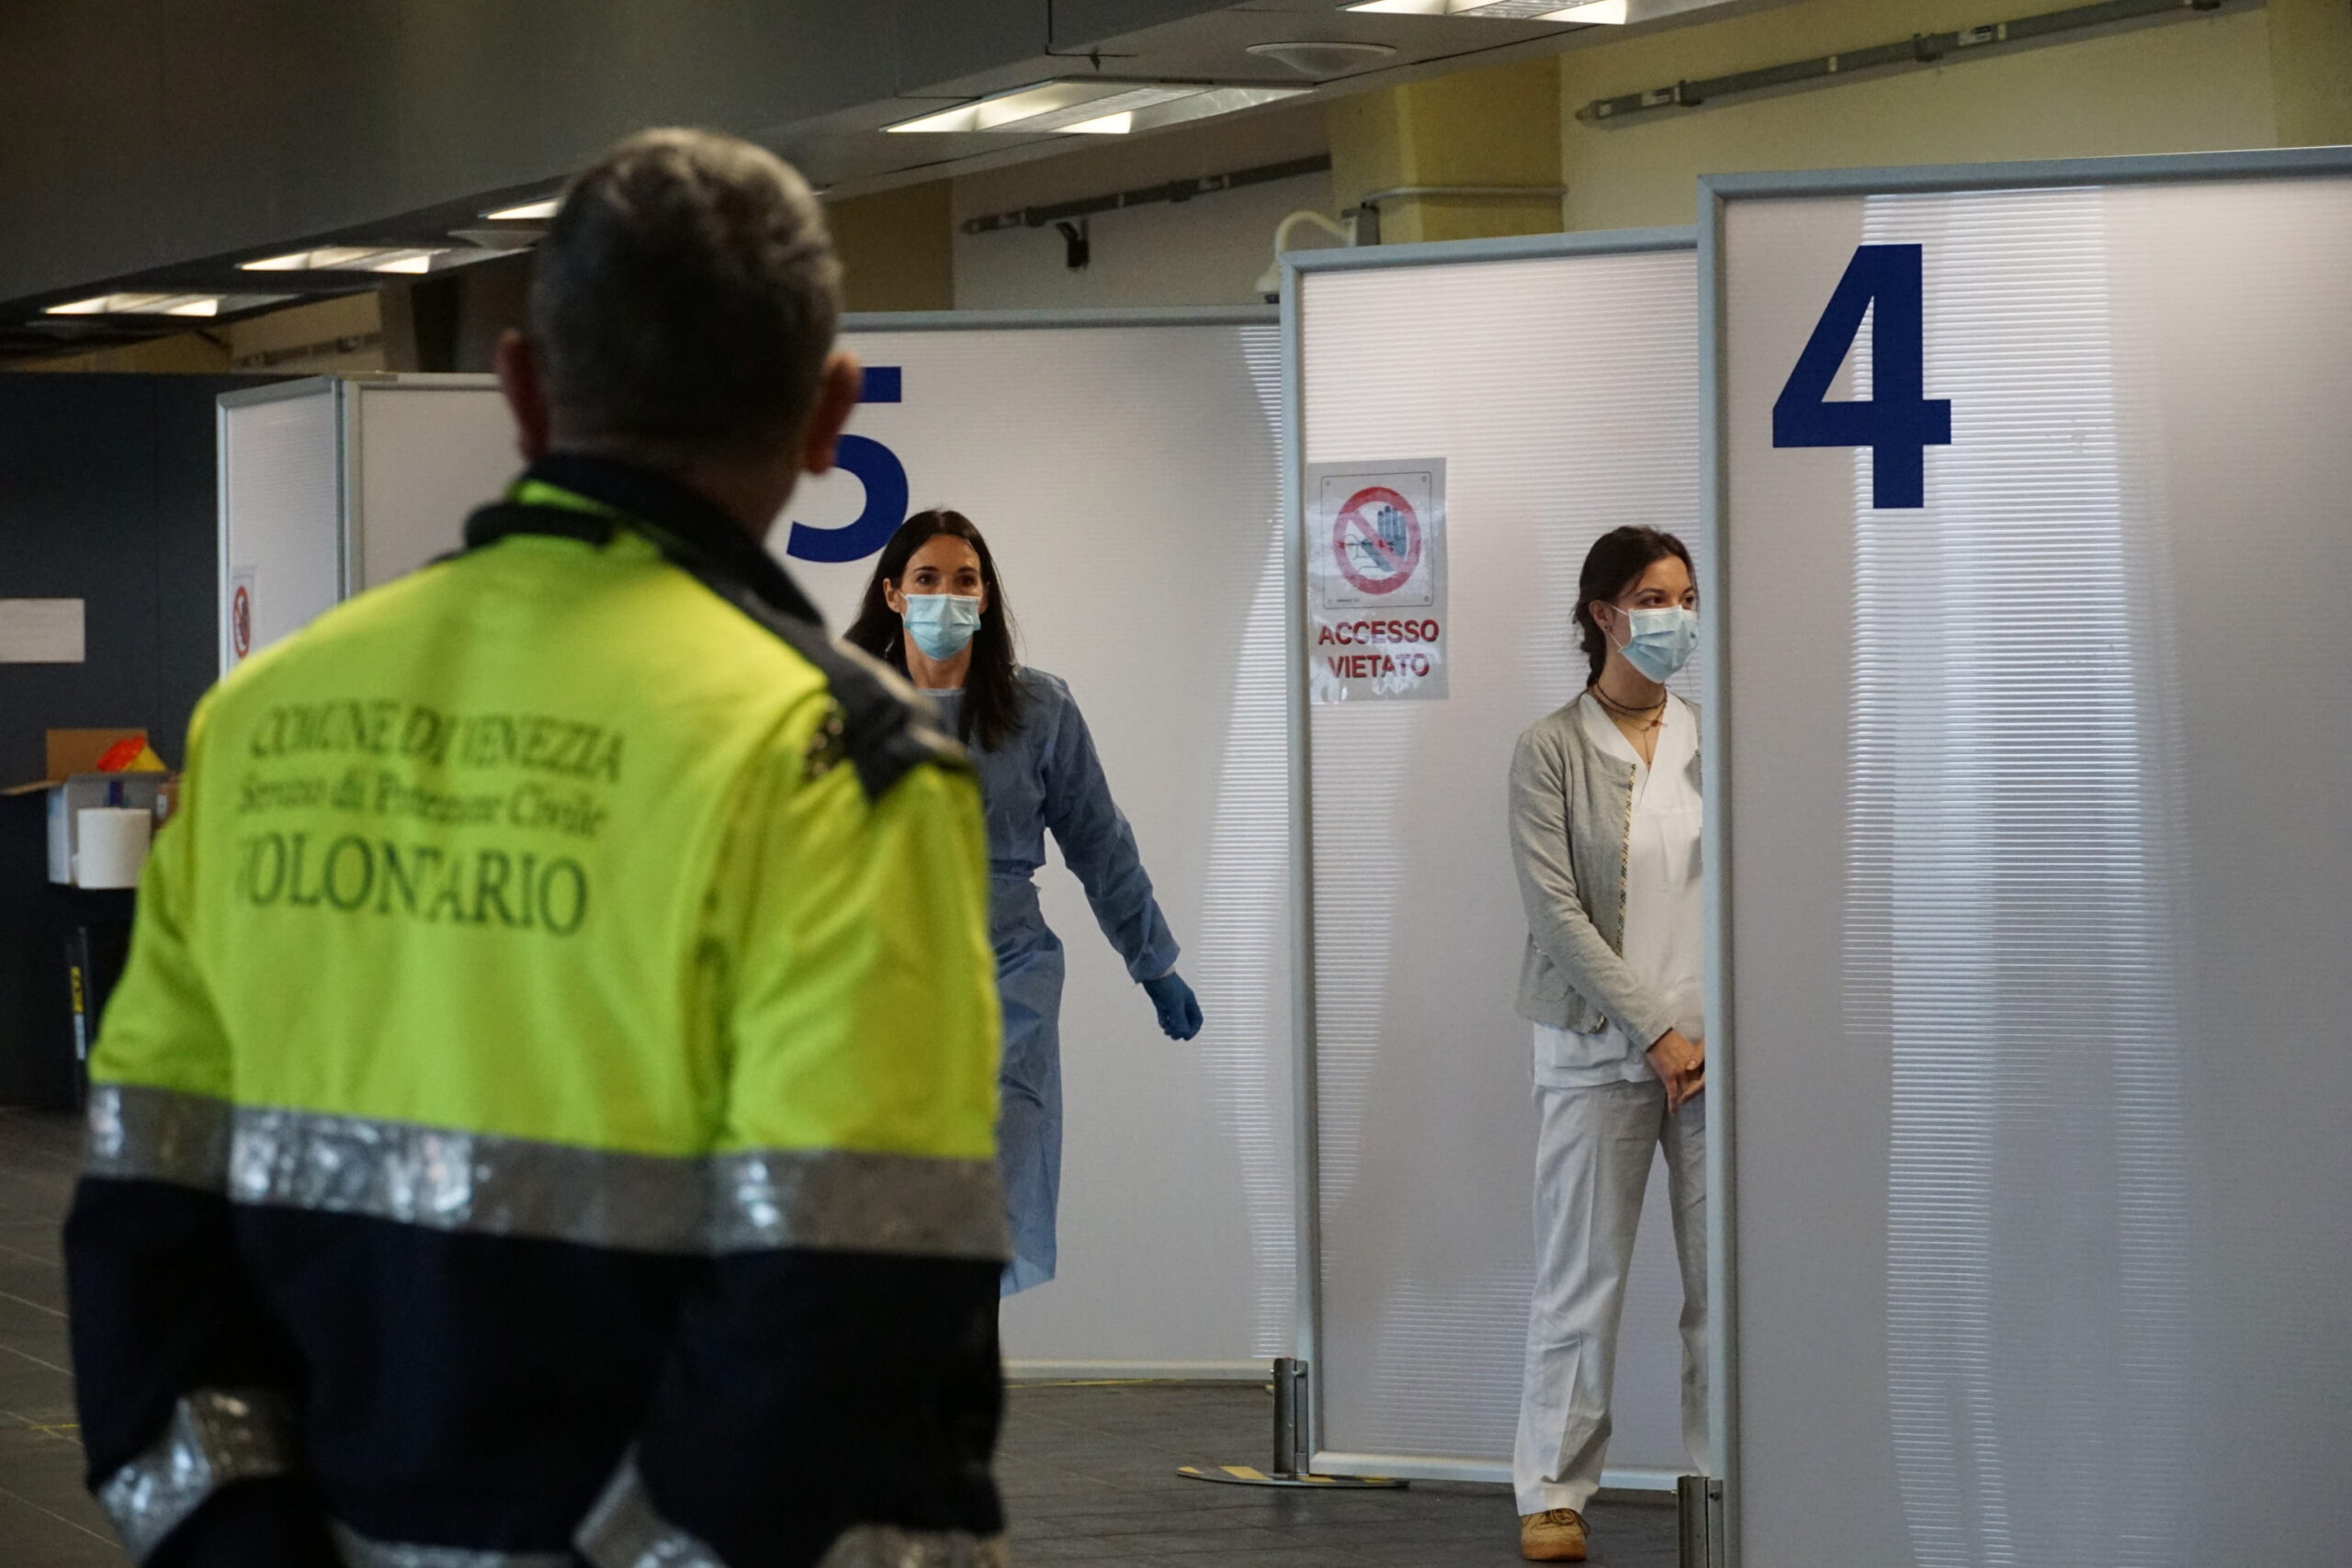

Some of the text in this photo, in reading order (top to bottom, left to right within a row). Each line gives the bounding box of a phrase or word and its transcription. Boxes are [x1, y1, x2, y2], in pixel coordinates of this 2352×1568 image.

[1772, 243, 1951, 509] 4
[786, 366, 909, 563] 5
[1317, 619, 1440, 645] ACCESSO
[1328, 653, 1430, 678] VIETATO
[237, 830, 590, 938] OLONTARIO
